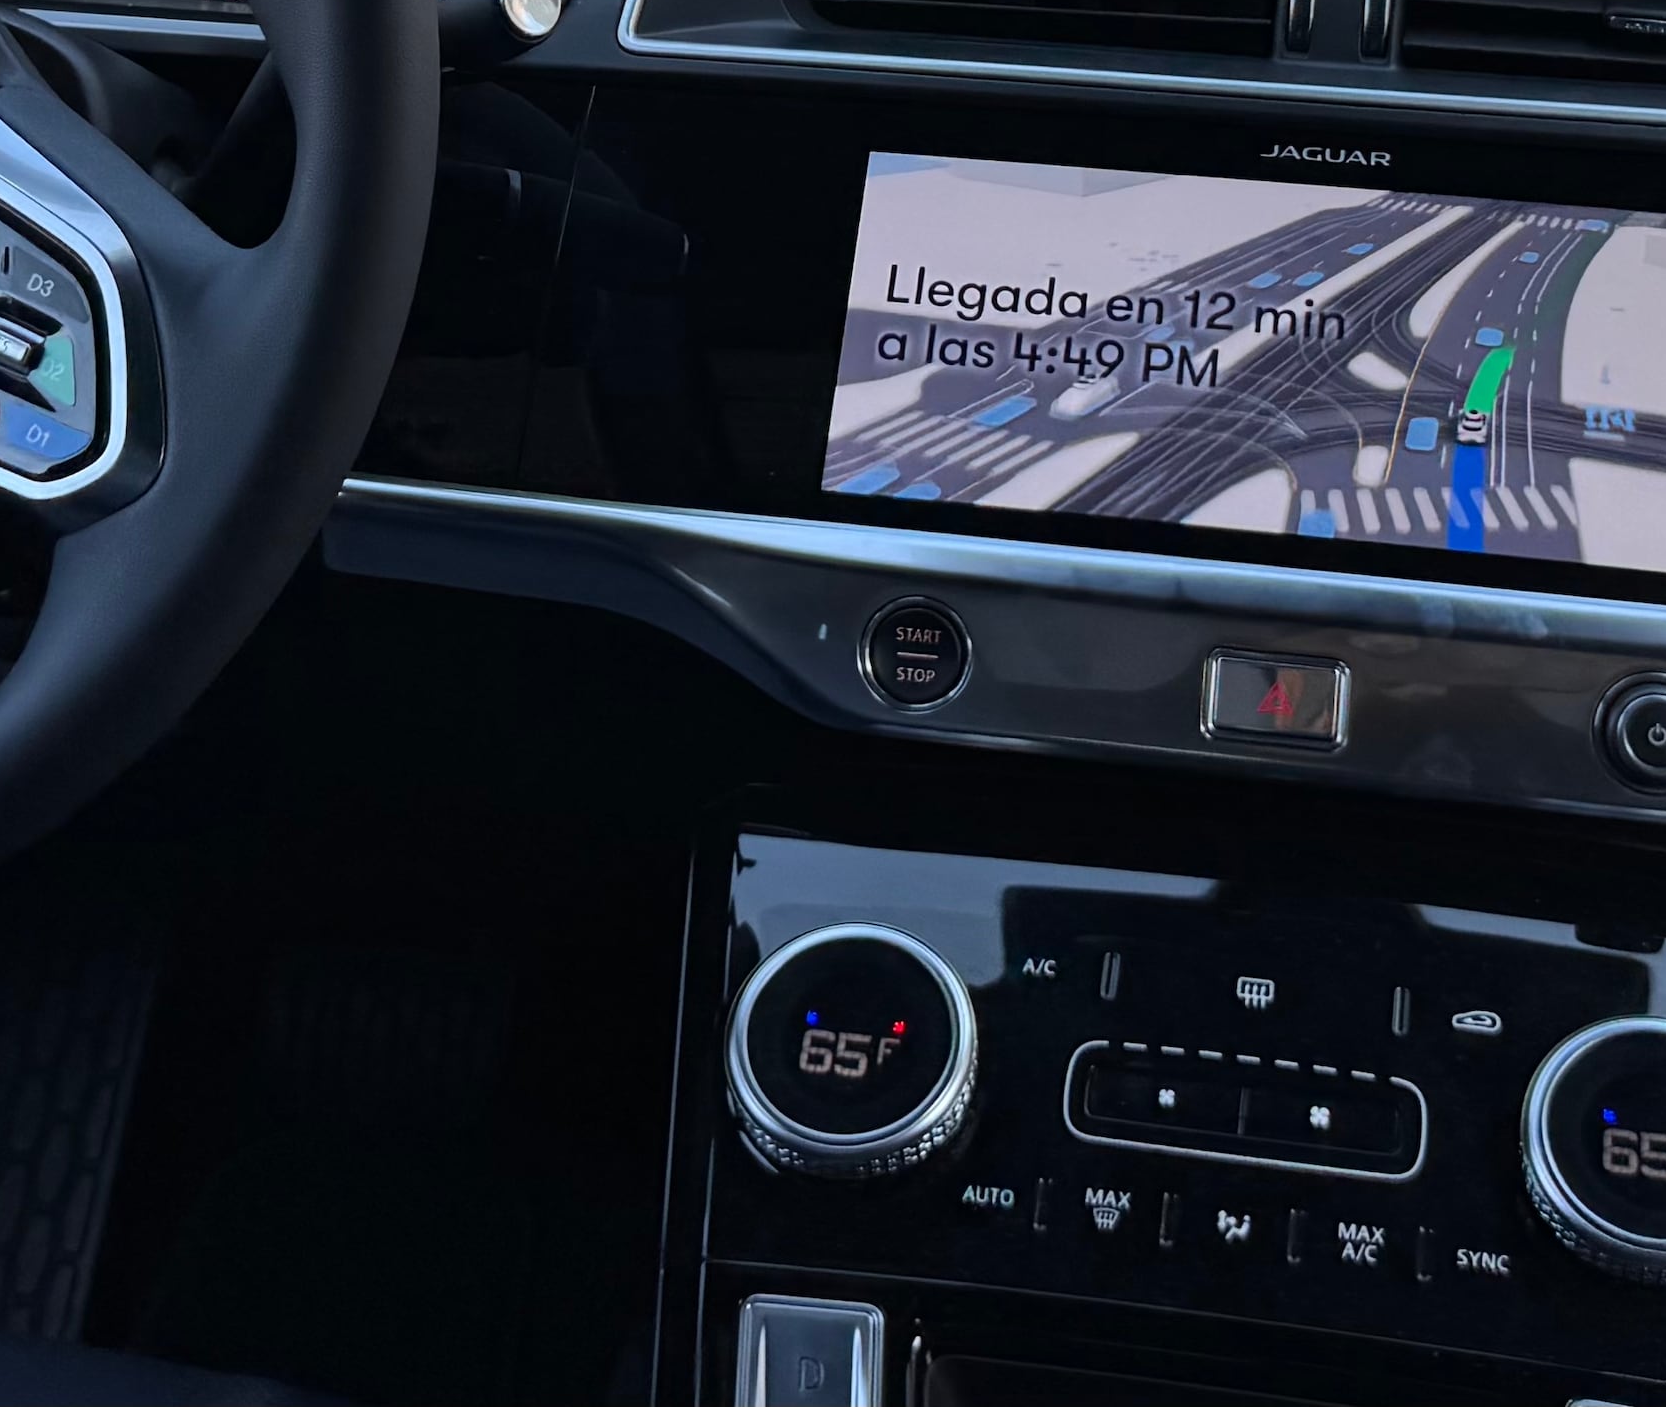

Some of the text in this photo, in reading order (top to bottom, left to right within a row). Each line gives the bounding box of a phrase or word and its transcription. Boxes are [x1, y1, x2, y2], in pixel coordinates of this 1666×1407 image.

[1260, 144, 1392, 167] JAGUAR
[26, 273, 56, 297] D3
[886, 262, 1347, 341] Llegada en 12 min
[877, 323, 1220, 388] a las 4:49 PM
[25, 423, 50, 448] D1
[895, 626, 942, 644] START
[895, 666, 936, 683] STOP
[1022, 958, 1057, 979] A/C
[798, 1028, 873, 1078] 65
[961, 1184, 1015, 1210] AUTO
[1084, 1187, 1132, 1211] MAX
[1337, 1222, 1386, 1245] MAX
[1342, 1242, 1379, 1264] A/C
[1456, 1248, 1512, 1276] SYNC
[798, 1355, 826, 1393] D
